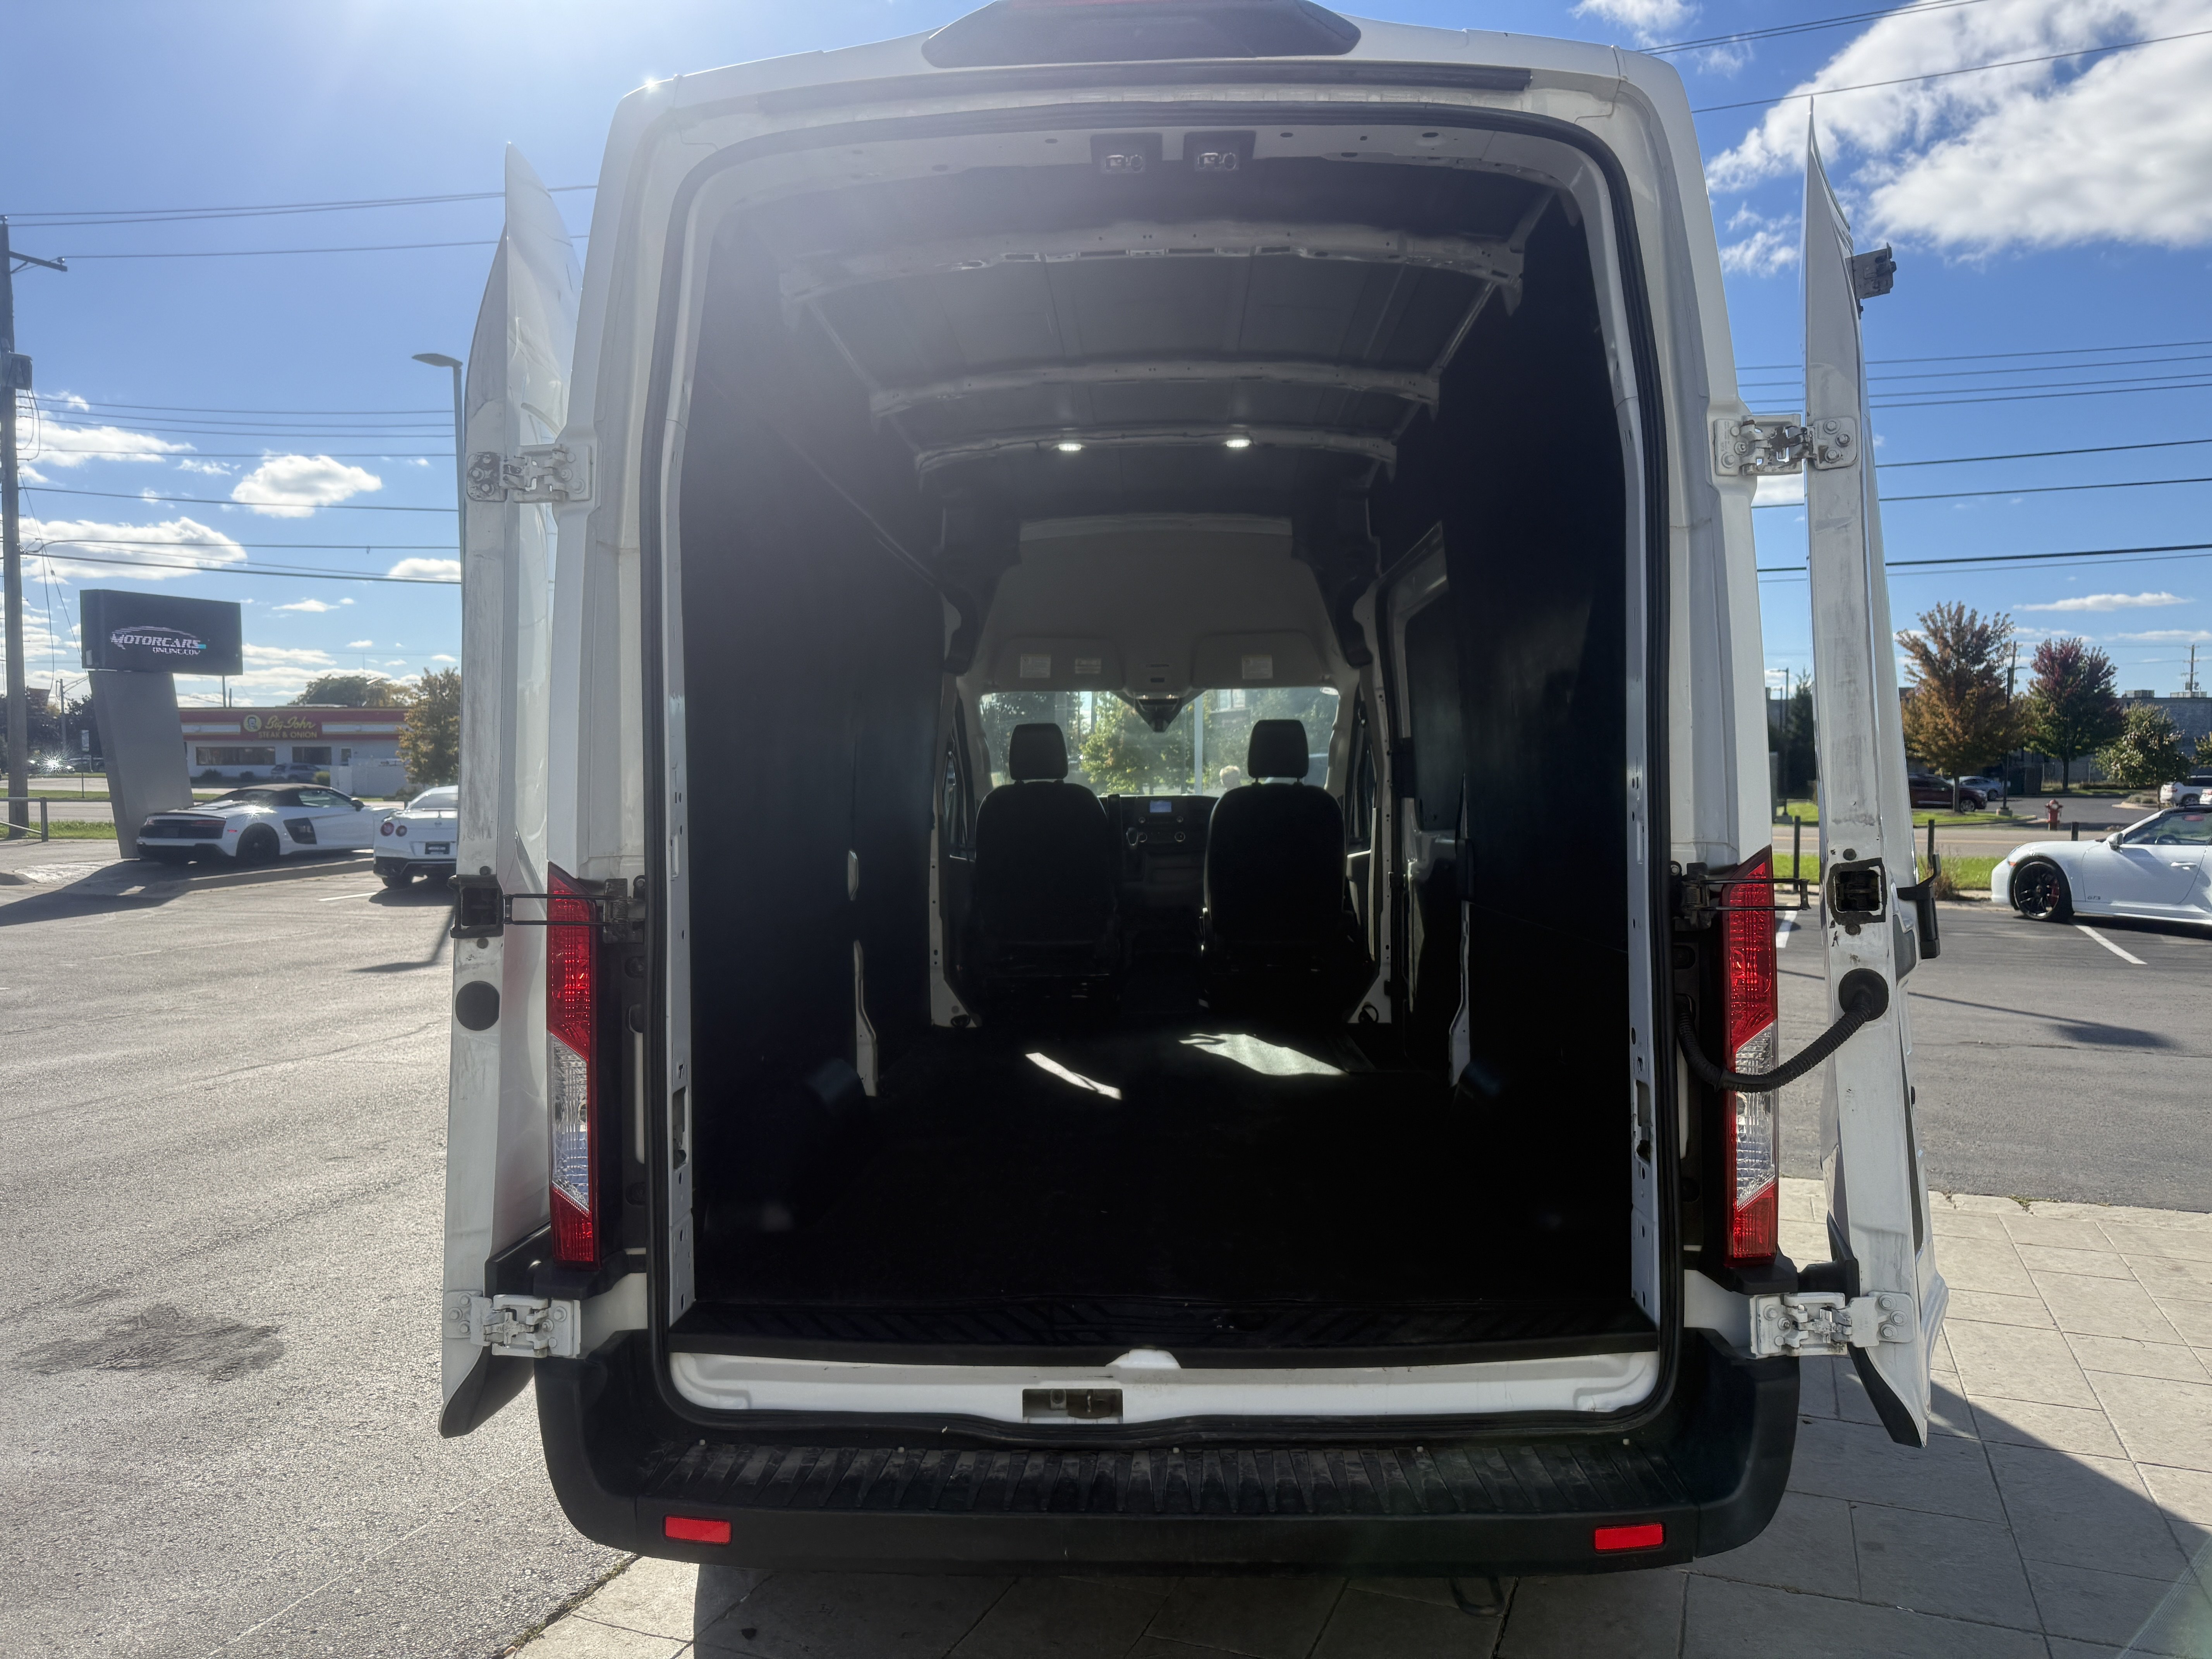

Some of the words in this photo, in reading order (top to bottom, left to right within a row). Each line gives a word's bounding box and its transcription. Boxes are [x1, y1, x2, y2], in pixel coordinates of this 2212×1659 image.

[110, 634, 201, 649] MOTORCARS
[265, 716, 283, 731] Big
[283, 716, 316, 729] John
